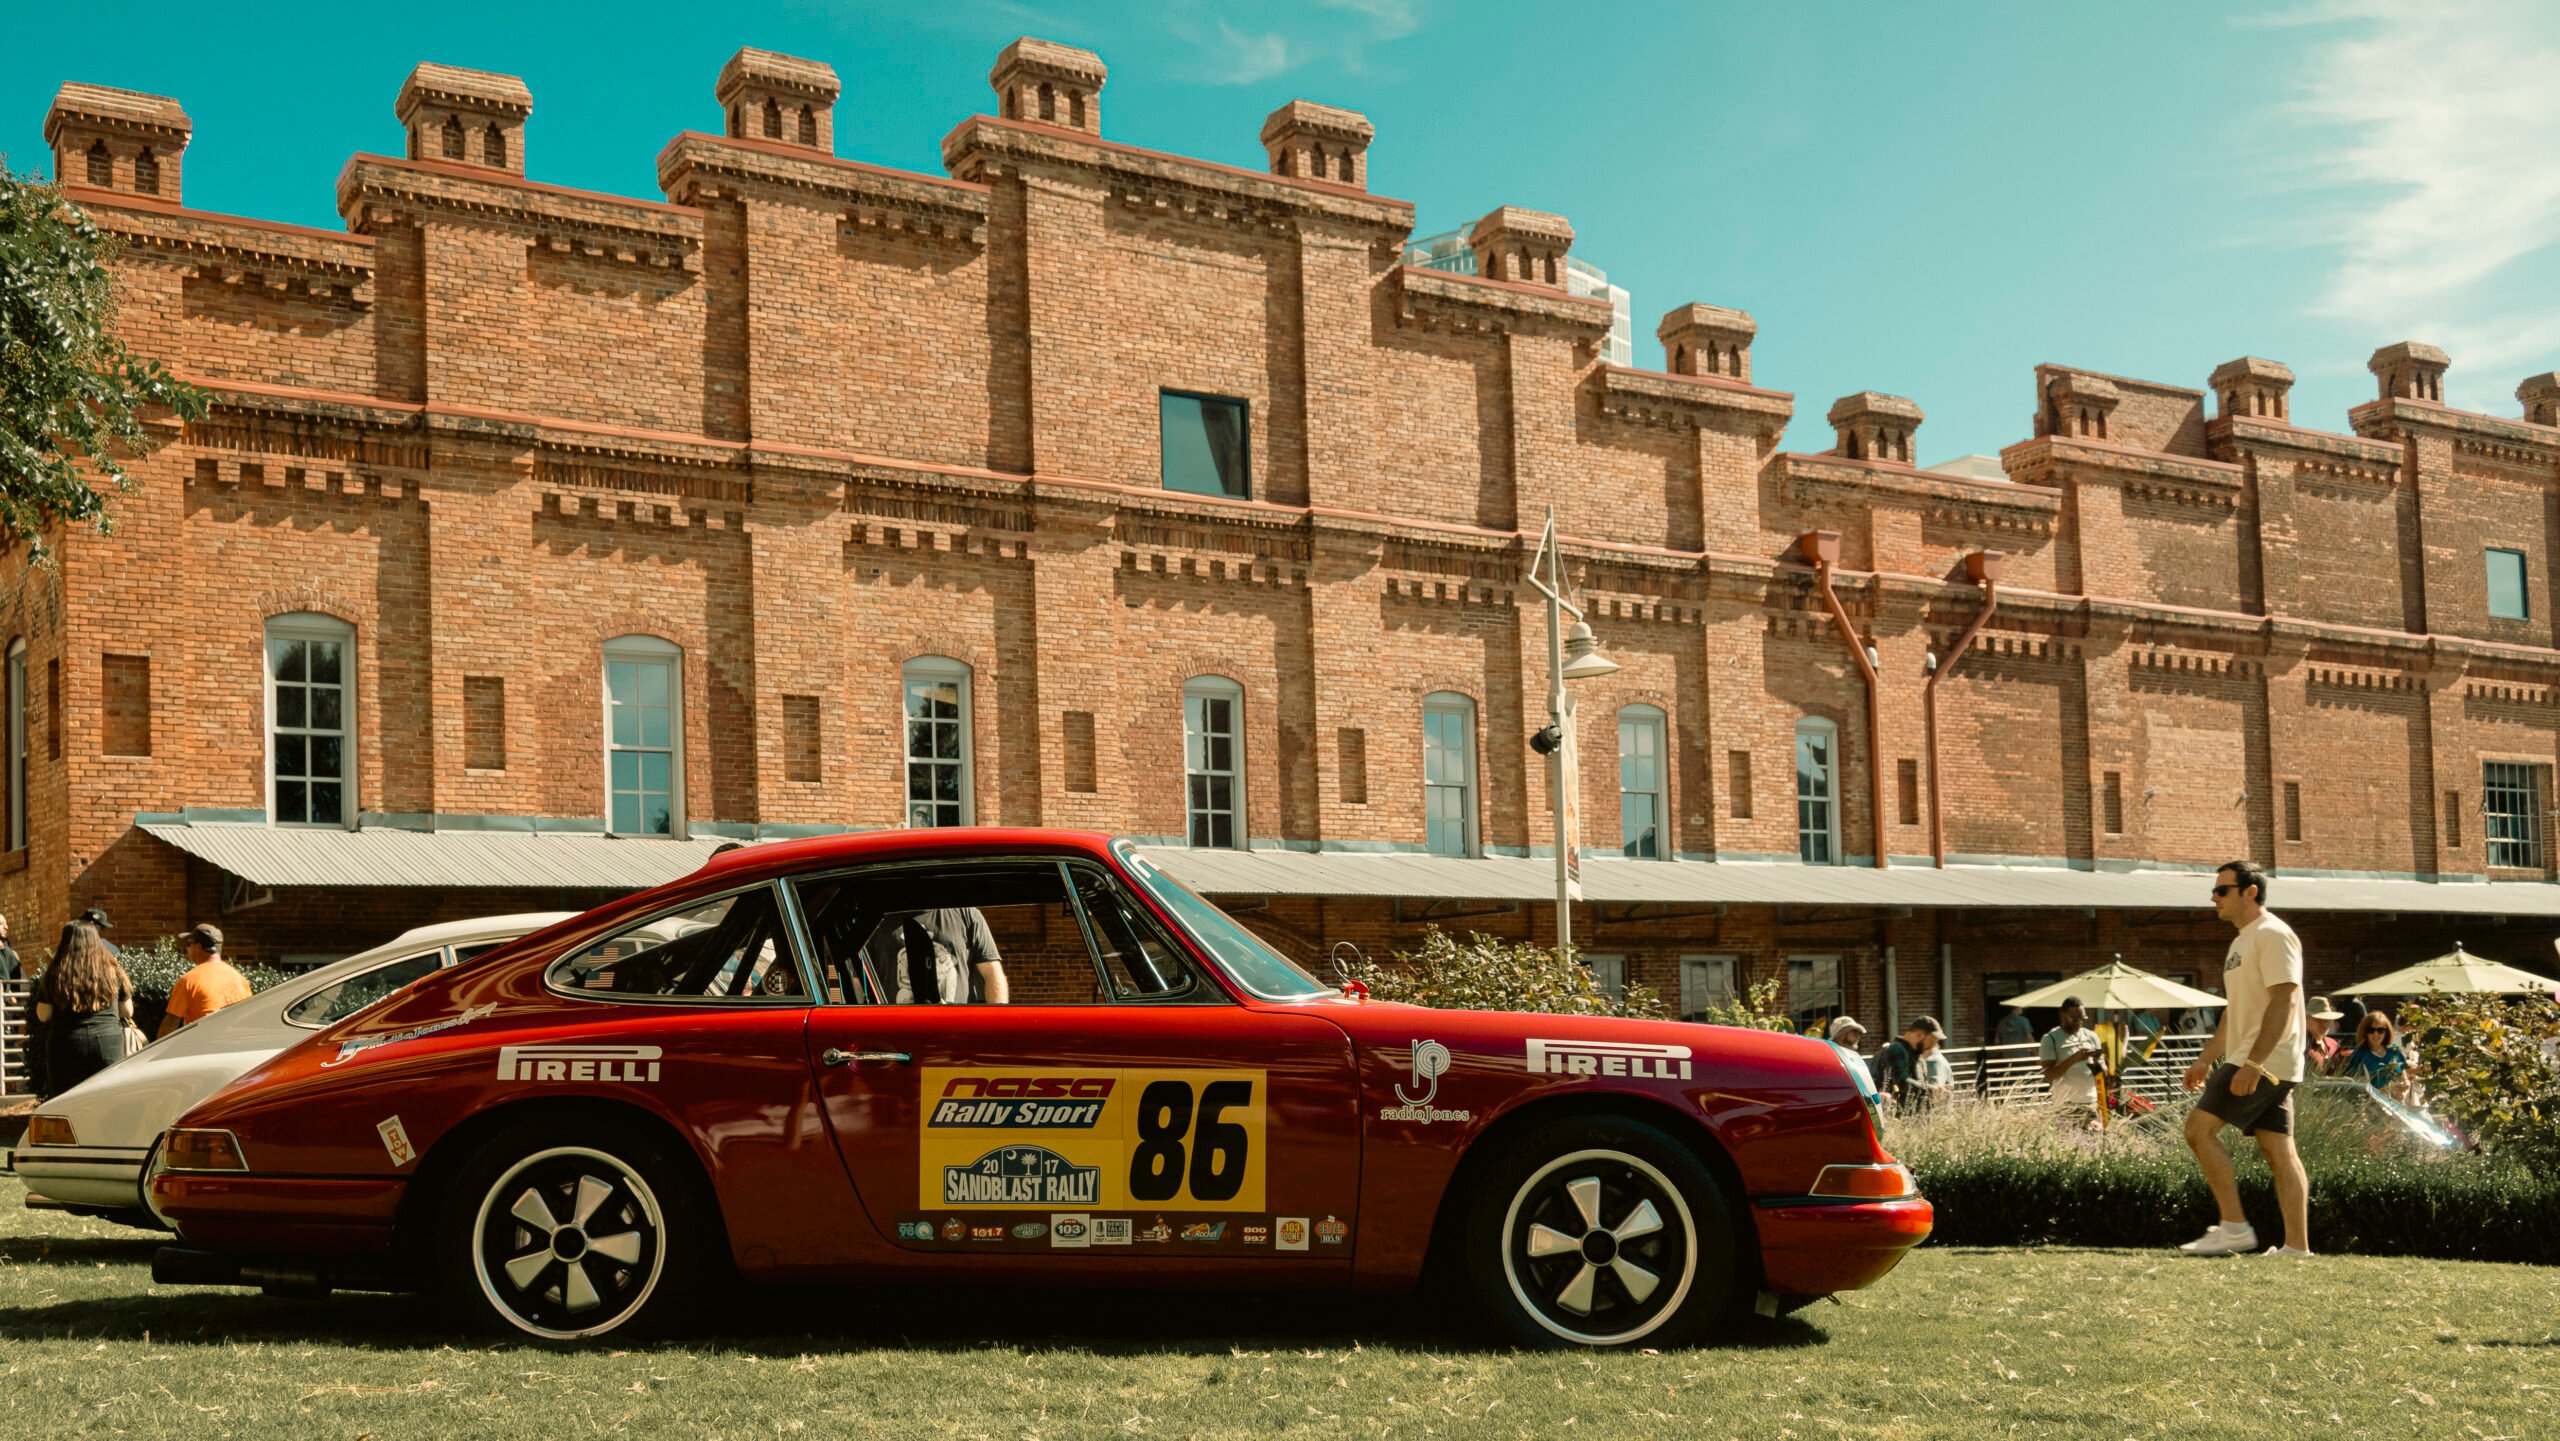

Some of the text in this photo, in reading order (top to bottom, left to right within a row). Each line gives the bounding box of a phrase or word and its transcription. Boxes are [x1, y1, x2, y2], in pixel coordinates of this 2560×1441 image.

[497, 1045, 663, 1082] PIRELLI
[1526, 1038, 1693, 1080] PIRELLI
[935, 1102, 1099, 1126] Rally Sport
[1380, 1105, 1470, 1125] radioJones
[389, 1130, 407, 1157] TOW
[1129, 1080, 1253, 1202] 86
[982, 1159, 1000, 1175] 20
[1044, 1159, 1060, 1174] 17
[947, 1169, 1097, 1202] SANDBLAST RALLY
[972, 1228, 1003, 1237] 101.7
[1057, 1224, 1084, 1235] 103!
[1195, 1230, 1217, 1238] Rocket
[1319, 1223, 1345, 1234] BETTER
